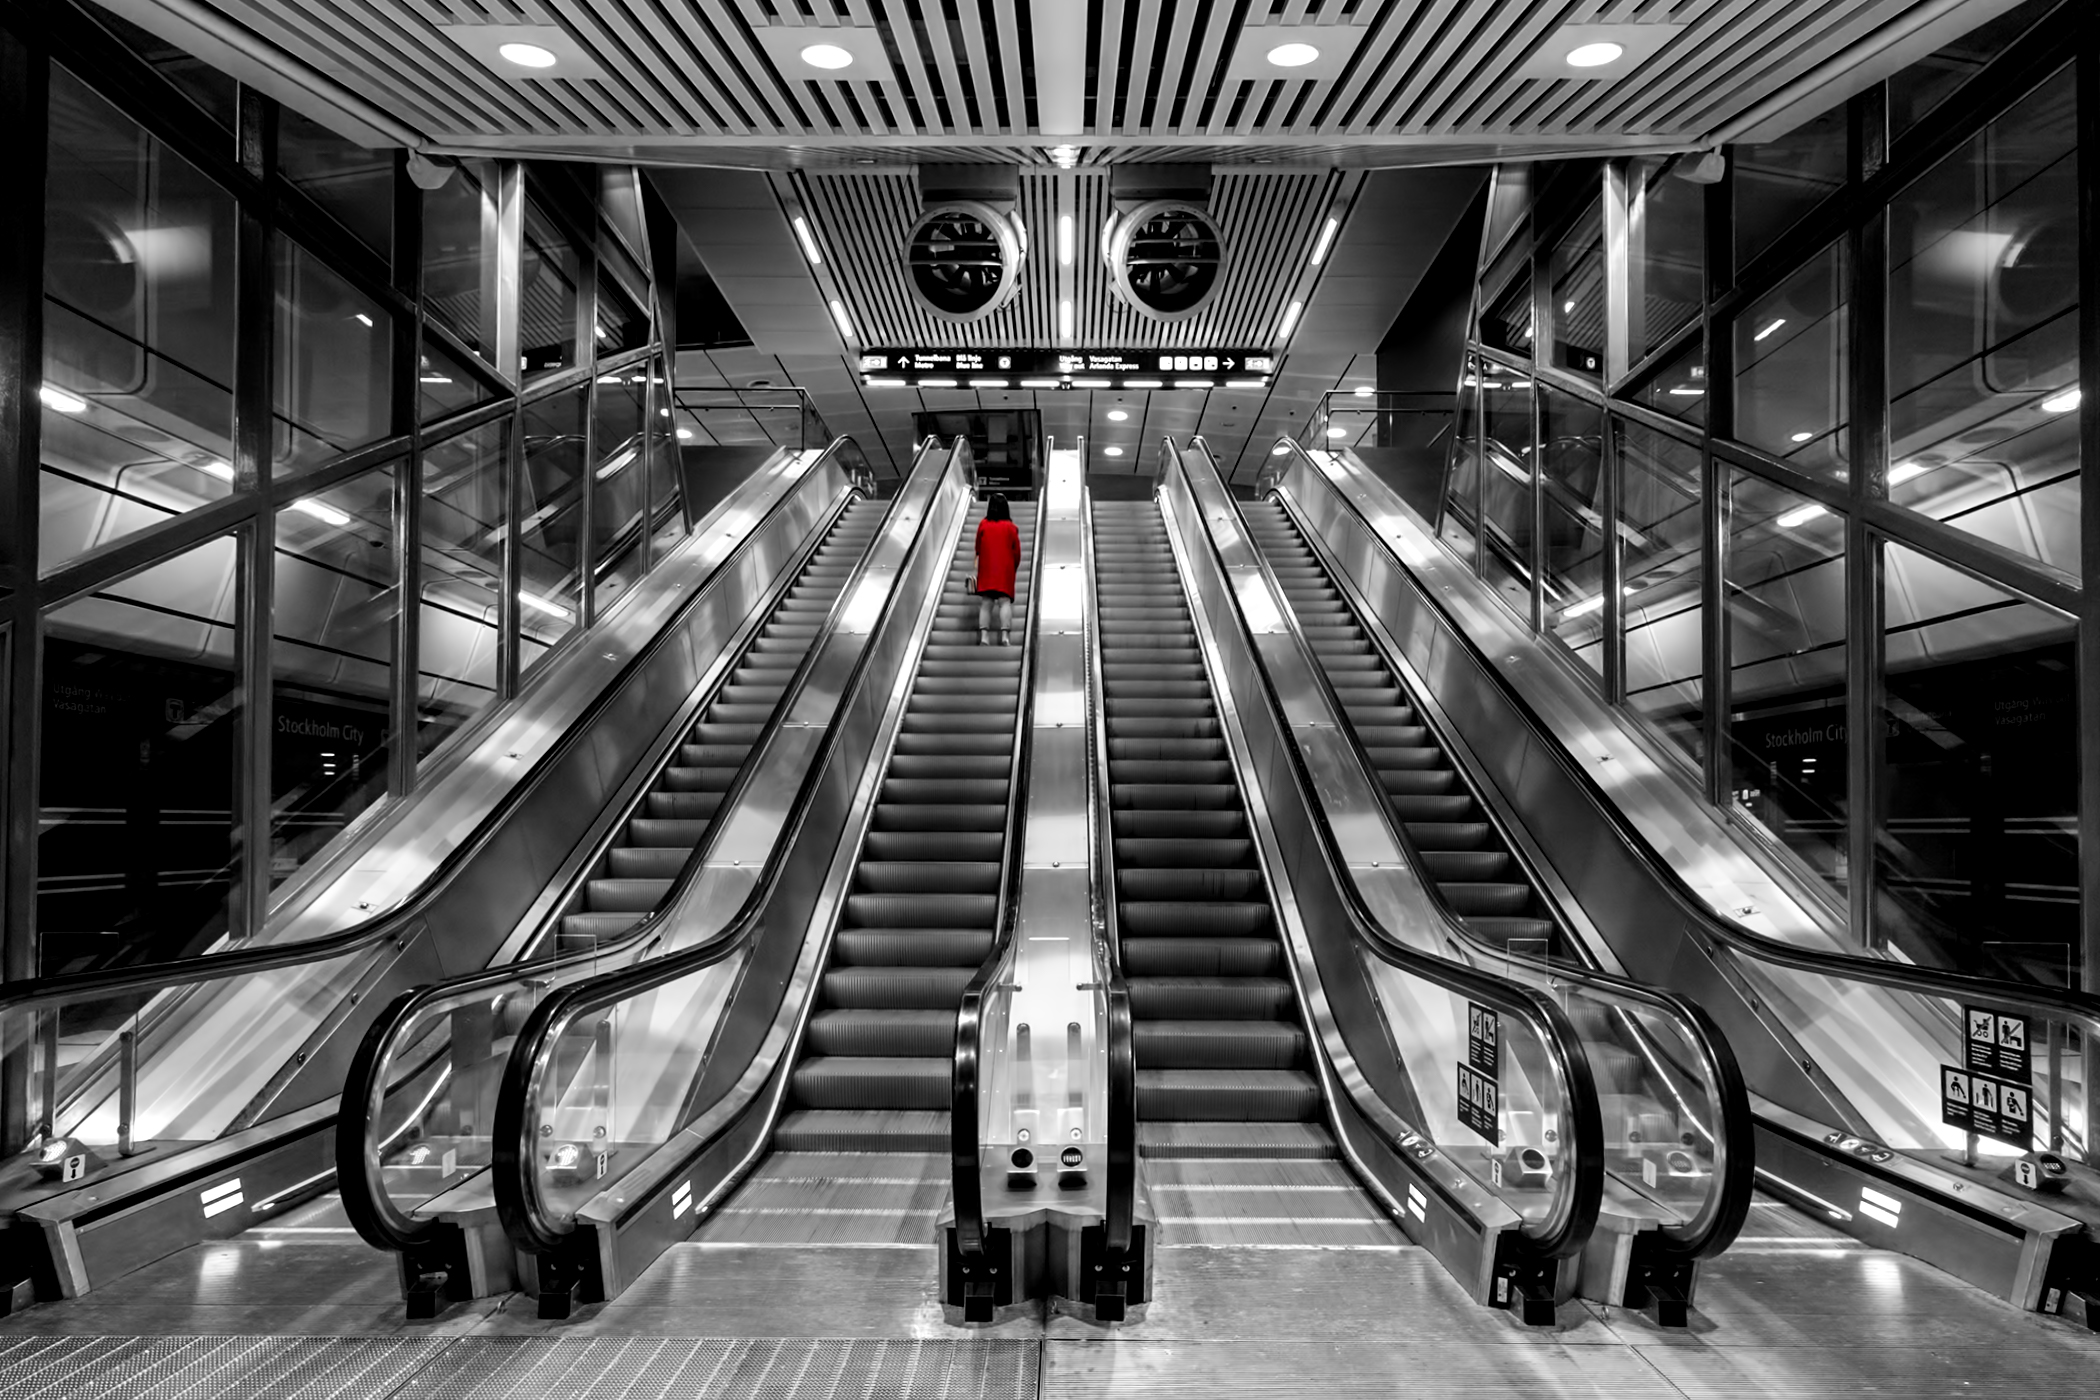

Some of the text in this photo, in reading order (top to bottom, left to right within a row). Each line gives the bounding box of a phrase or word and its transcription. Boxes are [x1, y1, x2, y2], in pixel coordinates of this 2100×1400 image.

[1059, 355, 1082, 364] Utgång
[1089, 355, 1122, 364] Vasagatan
[1115, 363, 1140, 371] Express
[52, 698, 107, 715] Vasagatan
[1994, 712, 2046, 727] Vasagatan
[277, 714, 365, 747] Stockholm City
[1765, 727, 1823, 748] Stockholm
